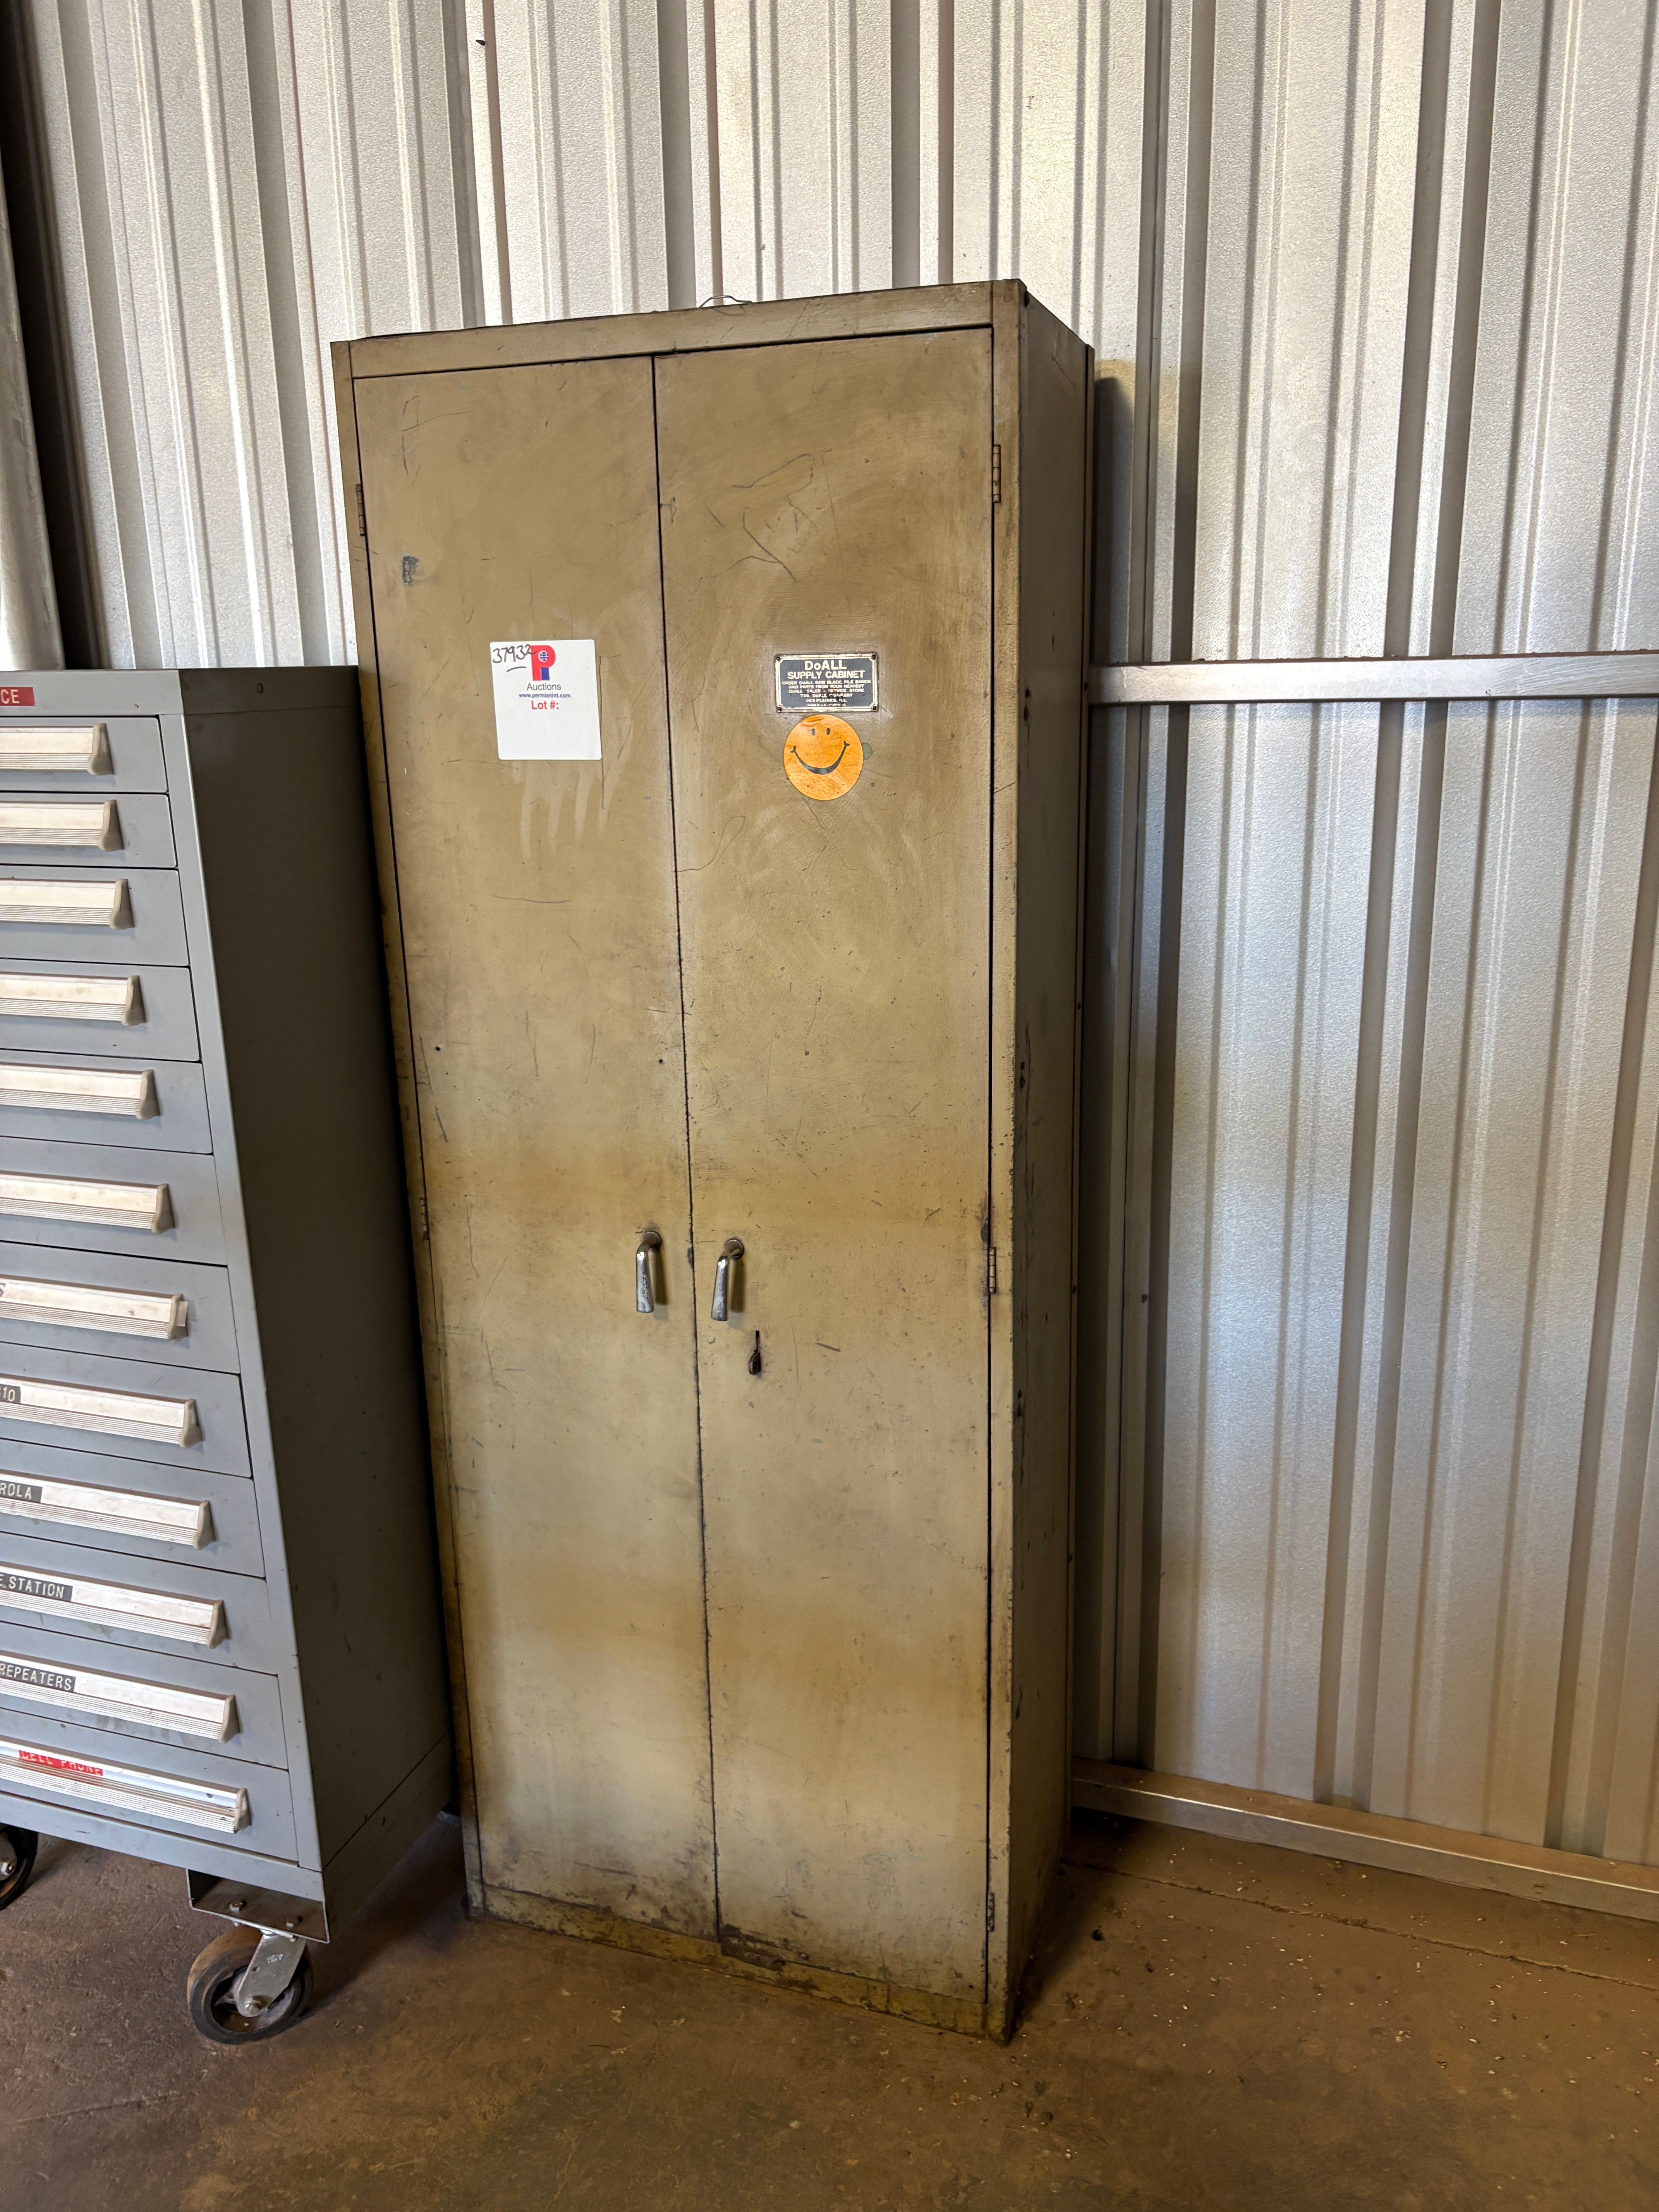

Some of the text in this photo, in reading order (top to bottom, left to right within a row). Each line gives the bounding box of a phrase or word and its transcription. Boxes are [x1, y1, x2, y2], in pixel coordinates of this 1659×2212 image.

[493, 644, 538, 663] 37932
[804, 659, 847, 670] DoALL
[787, 670, 866, 680] SUPPLY CABINET
[0, 689, 20, 704] CE
[531, 700, 559, 709] Lot #:
[0, 1482, 31, 1499] ROLA
[9, 1576, 64, 1598] STATION
[0, 1663, 72, 1691] REPEATERS
